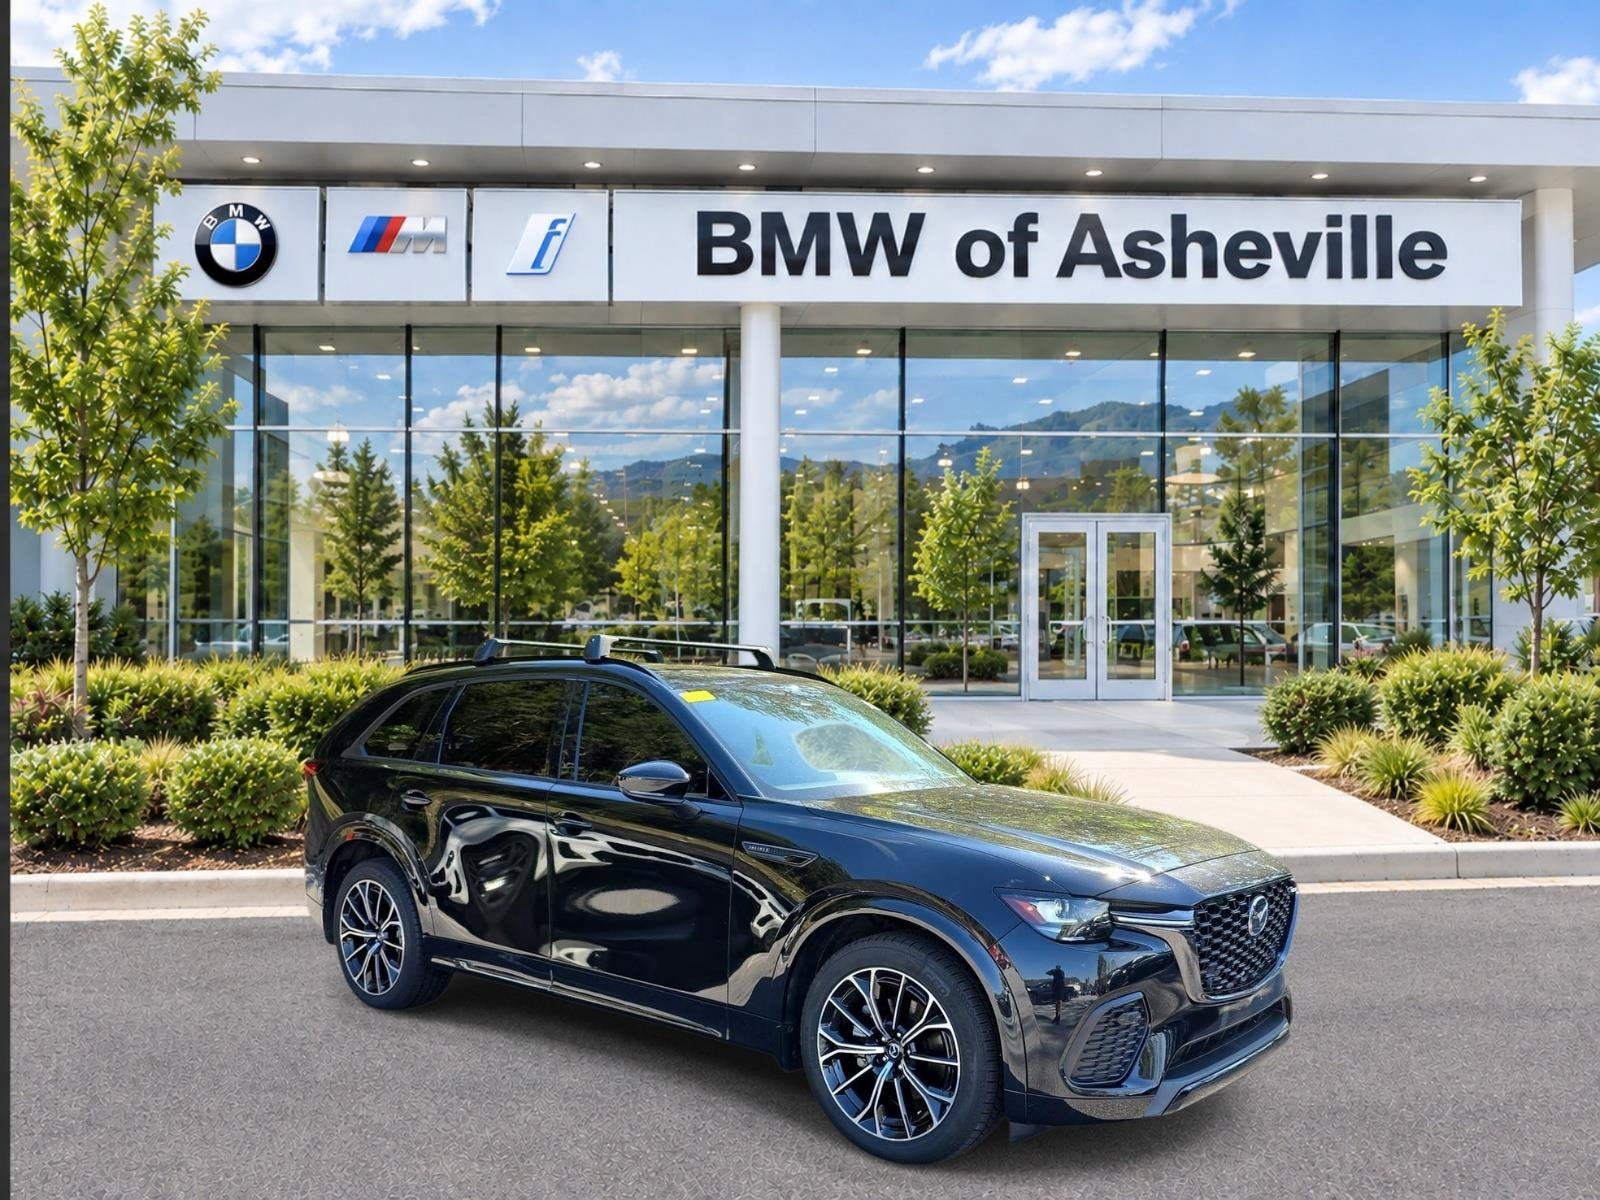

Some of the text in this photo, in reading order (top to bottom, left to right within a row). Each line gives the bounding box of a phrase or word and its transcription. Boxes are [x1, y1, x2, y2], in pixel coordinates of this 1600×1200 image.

[203, 204, 271, 231] BMW
[696, 210, 1448, 281] BMW of Asheville
